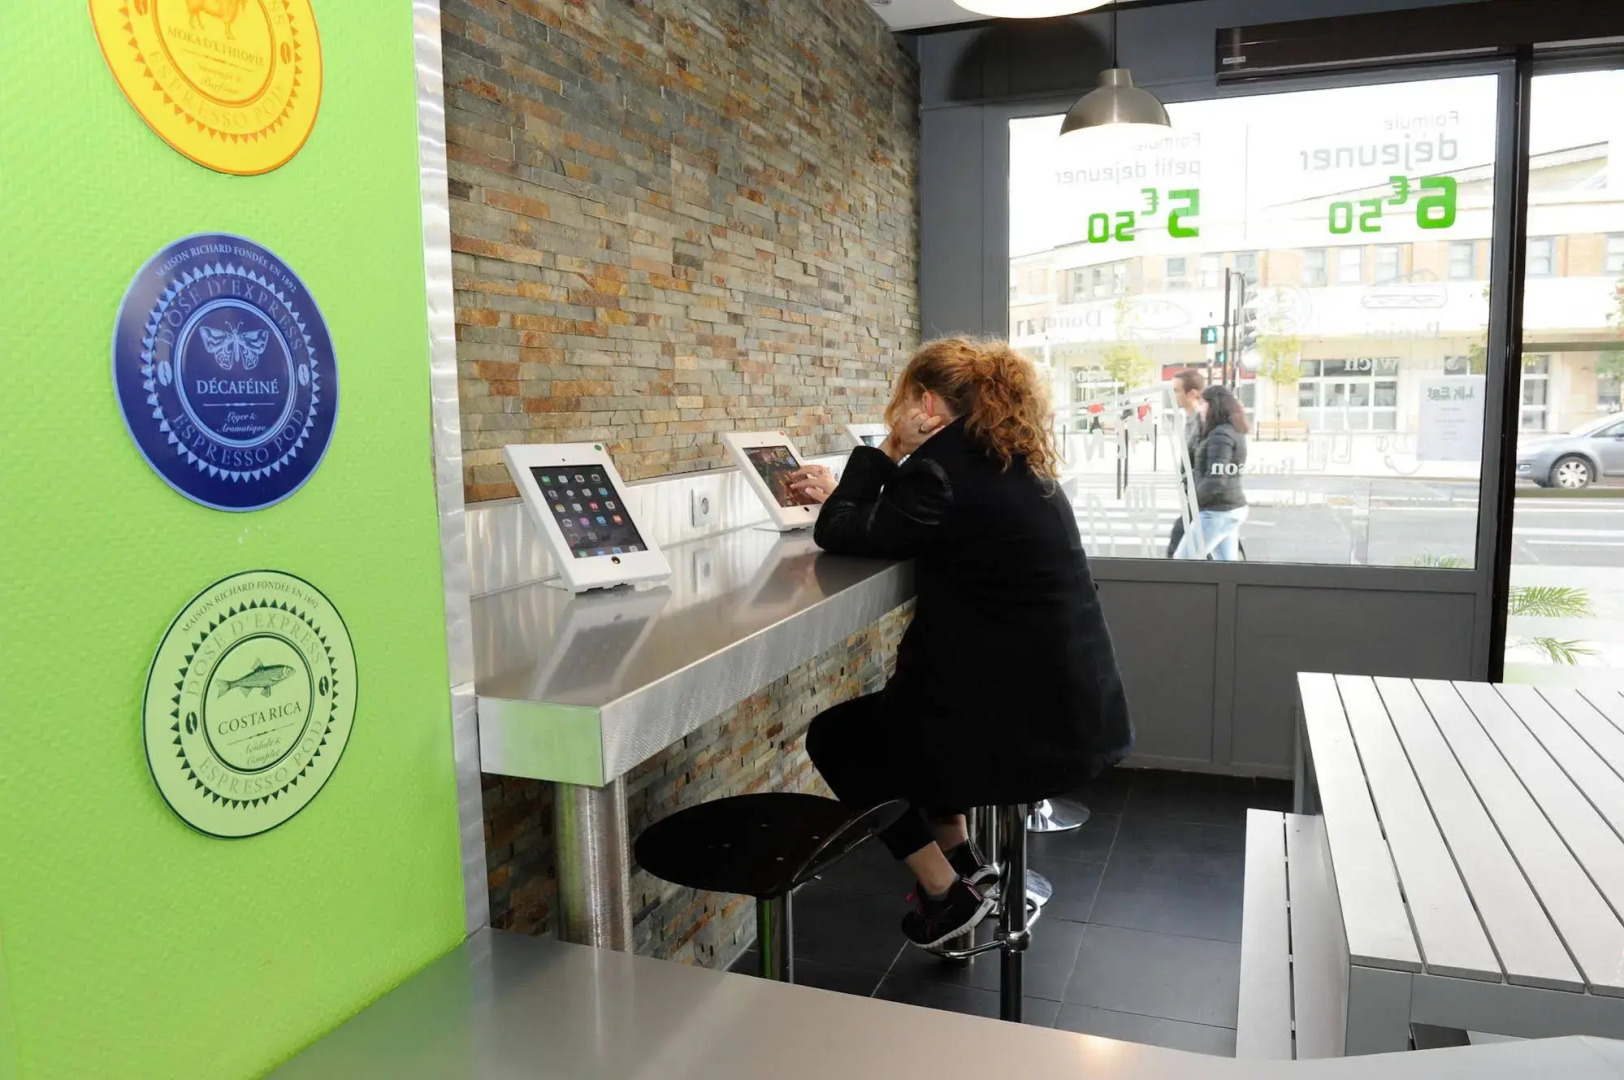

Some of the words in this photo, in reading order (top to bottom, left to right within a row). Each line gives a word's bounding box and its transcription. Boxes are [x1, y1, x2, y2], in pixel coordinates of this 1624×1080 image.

[168, 26, 203, 47] MOKA
[149, 50, 248, 129] ESPRESSO
[254, 84, 285, 125] POD
[155, 249, 190, 280] MAISON
[190, 243, 232, 260] RICHARD
[233, 246, 269, 266] FONDÉE
[269, 263, 282, 277] EN
[281, 274, 297, 294] 1892
[160, 288, 201, 347] DOSE
[206, 277, 303, 351] D'EXPRESS
[196, 376, 280, 395] DÉCAFÉINÉ
[172, 411, 270, 468] ESPRESSO
[274, 408, 305, 453] POD
[216, 423, 266, 434] Aromatique
[182, 600, 215, 635] MAISON
[213, 582, 256, 605] RICHARD
[290, 585, 303, 598] EN
[303, 593, 319, 610] 1892
[186, 635, 224, 697] DOSE
[229, 612, 325, 665] D'EXPRESS
[217, 711, 266, 736] COSTA
[267, 700, 302, 721] RICA
[198, 755, 289, 795] ESPRESSO
[293, 719, 325, 767] POD
